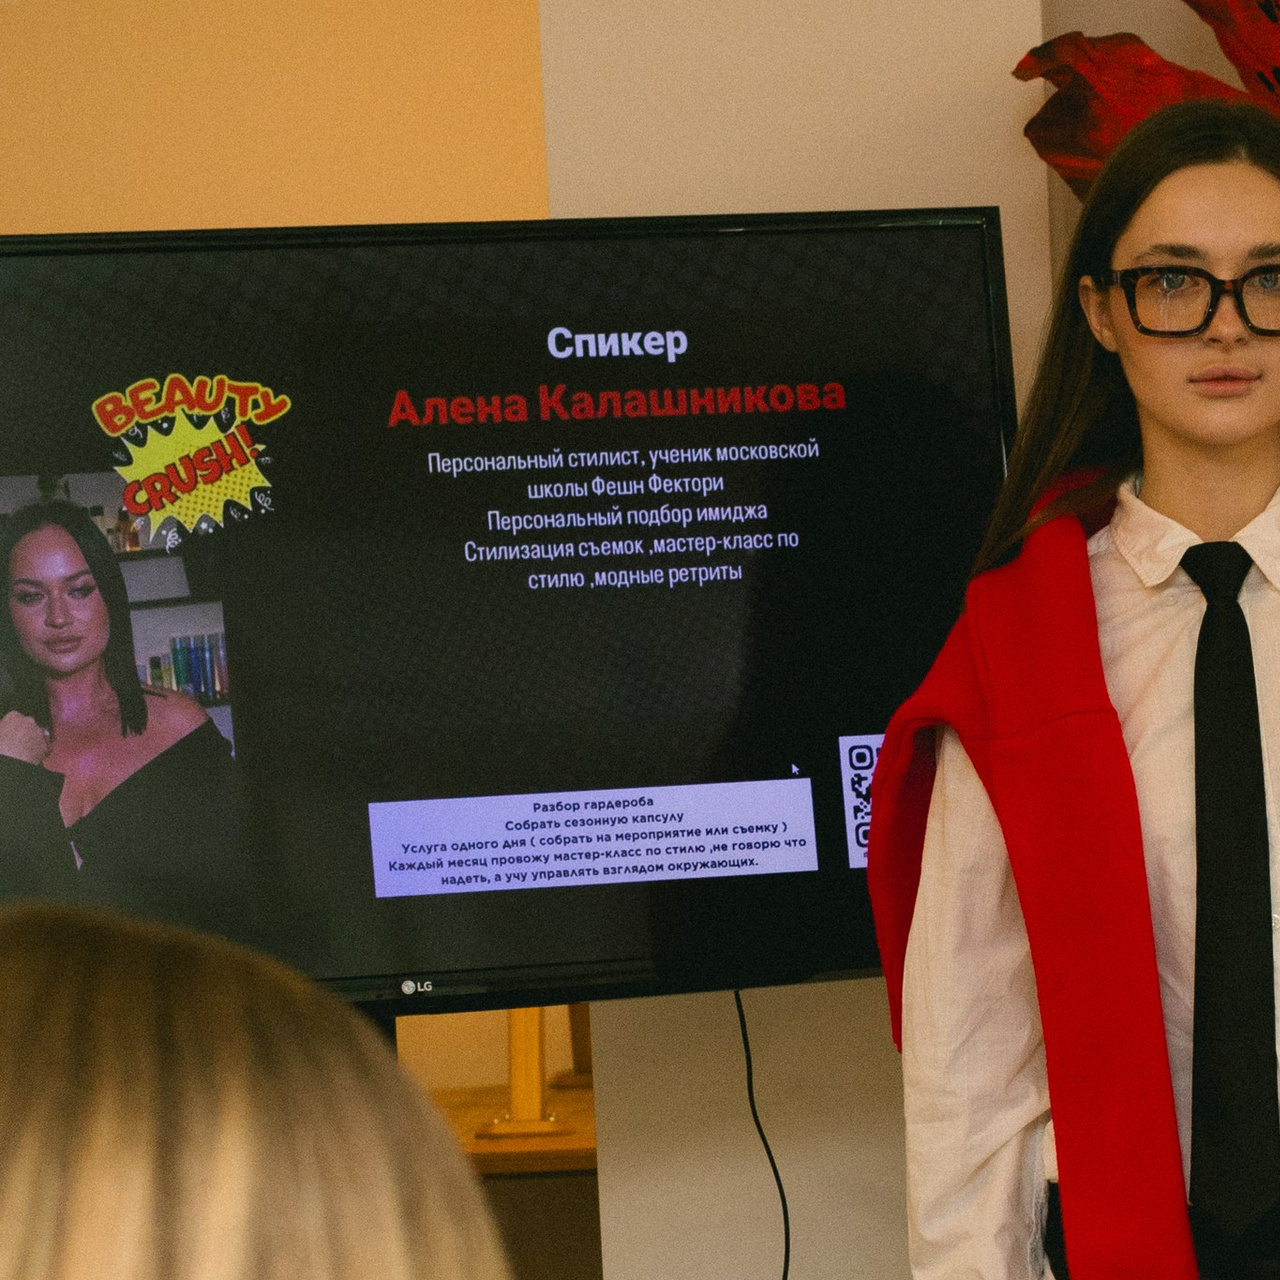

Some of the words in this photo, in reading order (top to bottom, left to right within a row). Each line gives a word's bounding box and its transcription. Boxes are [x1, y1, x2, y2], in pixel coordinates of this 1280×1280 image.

[547, 327, 688, 363] Спикер
[92, 373, 291, 437] BEAUTY
[387, 389, 528, 427] Алена
[538, 382, 847, 421] Калашникова
[122, 423, 258, 516] CRUSH!
[428, 447, 564, 478] Персональный
[568, 450, 646, 468] стилист,
[649, 447, 713, 470] ученик
[716, 438, 820, 462] московской
[527, 482, 588, 499] школы
[591, 476, 644, 496] Фешн
[648, 473, 724, 497] Фектори
[487, 505, 622, 536] Персональный
[627, 504, 693, 528] подбор
[697, 504, 768, 523] имиджа
[464, 541, 574, 562] Стилизация
[578, 539, 644, 557] съемок
[777, 532, 799, 547] по
[528, 572, 585, 589] стилю
[668, 565, 742, 588] ретриты
[533, 801, 580, 813] Разбор
[584, 796, 654, 811] гардероба
[504, 819, 561, 832] Собрать
[565, 815, 628, 828] сезонную
[632, 812, 684, 825] капсулу
[402, 842, 447, 854] Услуга
[451, 840, 499, 852] одного
[502, 839, 526, 850] дня
[539, 834, 593, 847] собрать
[597, 833, 611, 843] на
[615, 828, 702, 843] мероприятие
[705, 827, 729, 836] или
[732, 823, 778, 835] съемку
[389, 858, 444, 871] Каждый
[448, 857, 488, 868] месяц
[491, 853, 550, 866] провожу
[553, 848, 642, 861] мастер-класс
[646, 847, 661, 857] по
[665, 844, 706, 855] стилю
[732, 838, 781, 851] говорю
[784, 838, 807, 848] что
[441, 874, 491, 886] надеть,
[494, 873, 501, 882] а
[505, 871, 527, 882] учу
[531, 867, 599, 881] управлять
[603, 863, 664, 876] взглядом
[667, 857, 759, 872] окружающих.
[416, 981, 433, 992] LG
